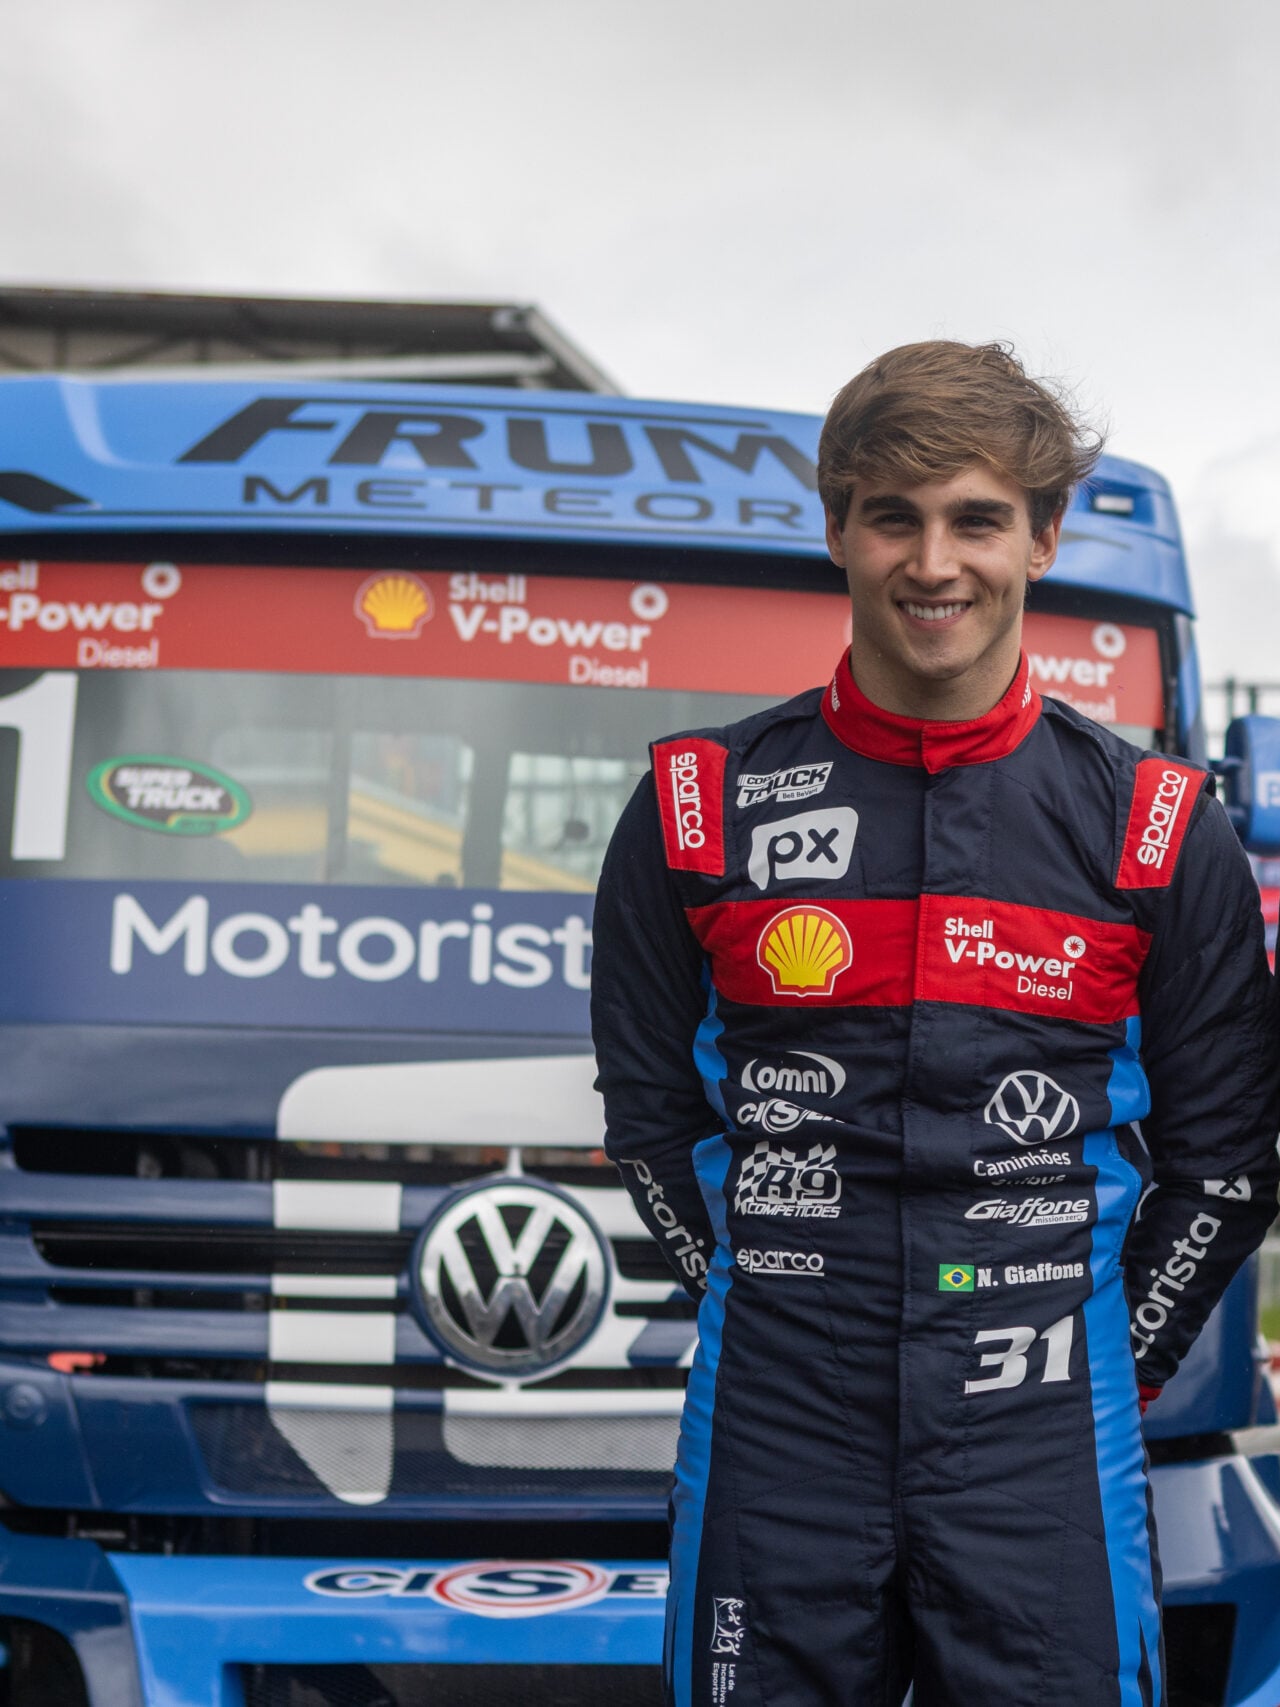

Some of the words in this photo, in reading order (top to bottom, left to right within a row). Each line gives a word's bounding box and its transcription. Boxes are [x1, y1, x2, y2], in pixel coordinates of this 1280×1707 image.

[244, 475, 804, 530] METEOR
[0, 560, 38, 591] ell
[449, 572, 526, 603] Shell
[0, 593, 163, 631] -Power
[449, 604, 651, 652] V-Power
[78, 637, 159, 667] Diesel
[569, 655, 648, 687] Diesel
[127, 785, 225, 811] TRUCK
[670, 752, 706, 850] sparco
[1138, 770, 1185, 869] sparco
[767, 827, 840, 881] px
[110, 892, 594, 989] Motorist
[944, 917, 993, 939] Shell
[944, 938, 1076, 979] V-Power
[1017, 975, 1073, 1001] Diesel
[757, 1065, 828, 1094] omni
[974, 1149, 1072, 1177] Caminhões
[964, 1197, 1090, 1224] Giaffone
[1035, 1215, 1064, 1224] mission
[737, 1248, 824, 1276] sparco
[977, 1268, 998, 1288] N.
[1004, 1262, 1084, 1285] Giaffone
[964, 1315, 1074, 1394] 31
[304, 1564, 669, 1604] CISE
[720, 1663, 728, 1703] Incentivo
[728, 1679, 735, 1691] de
